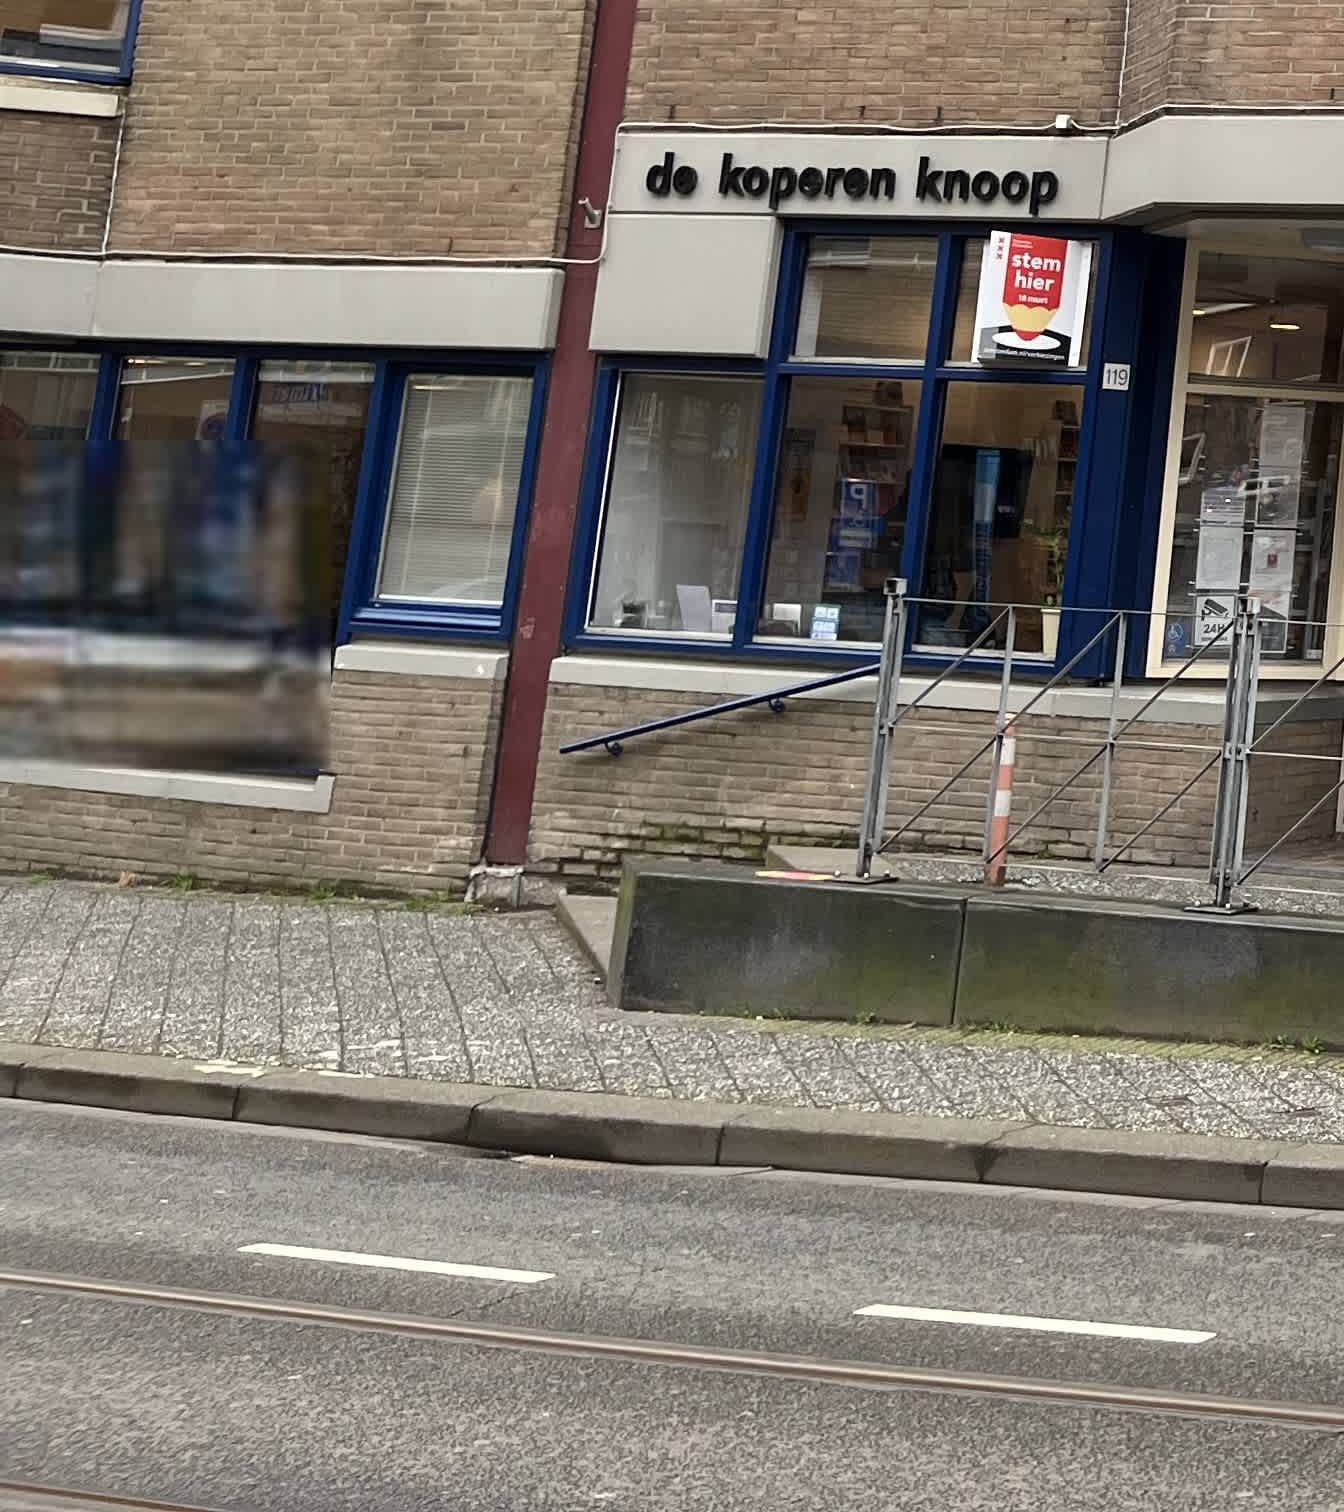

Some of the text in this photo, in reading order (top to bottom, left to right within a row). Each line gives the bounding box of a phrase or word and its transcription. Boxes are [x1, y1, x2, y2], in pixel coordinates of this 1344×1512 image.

[646, 151, 1060, 216] de koperen knoop
[1011, 252, 1061, 273] stem
[1014, 269, 1055, 292] hier
[1106, 368, 1128, 386] 119
